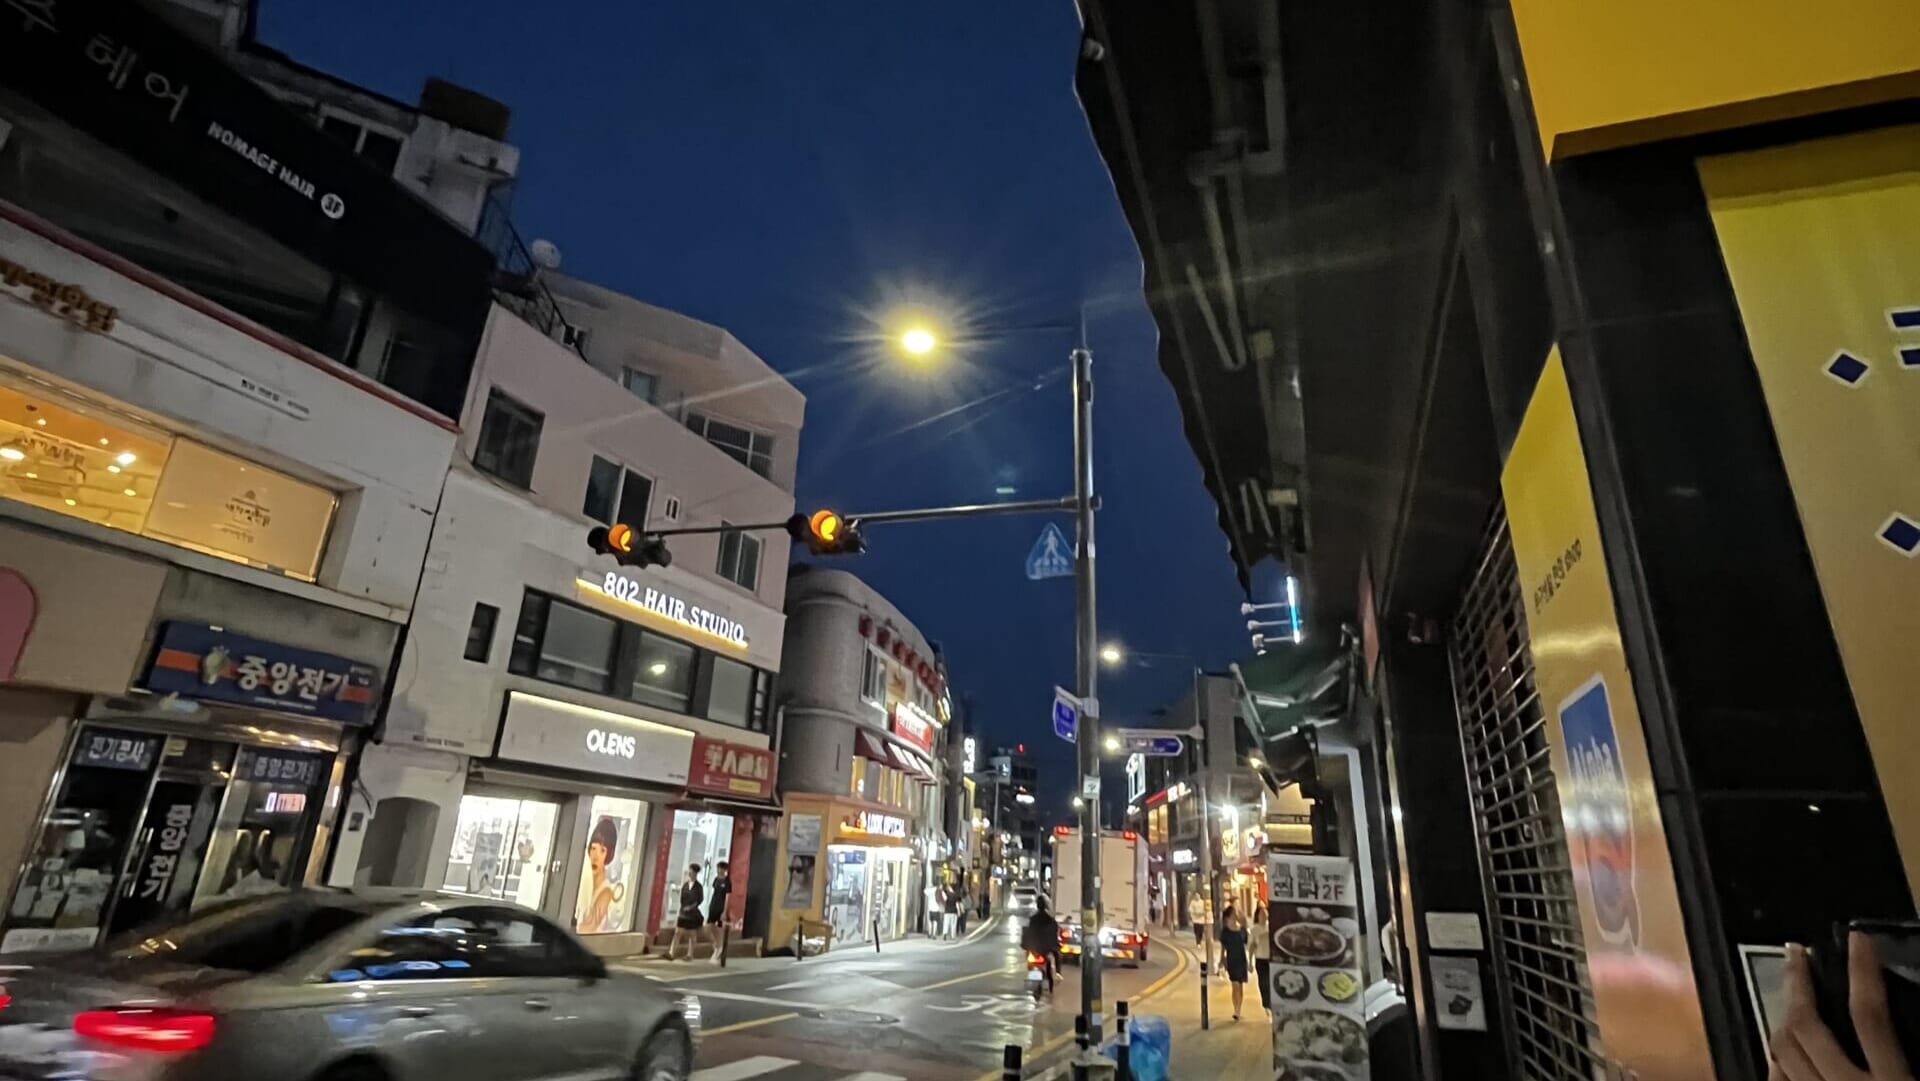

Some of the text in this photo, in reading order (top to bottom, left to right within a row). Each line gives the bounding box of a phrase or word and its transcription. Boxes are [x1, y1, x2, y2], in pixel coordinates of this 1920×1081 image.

[85, 32, 190, 123] 헤어
[278, 166, 316, 201] HAIR
[603, 571, 745, 642] 802 HAIR STUDIO
[237, 655, 350, 699] 중앙전기
[586, 728, 636, 759] OLENS
[141, 803, 194, 902] 중앙전기
[1322, 884, 1344, 900] 2F
